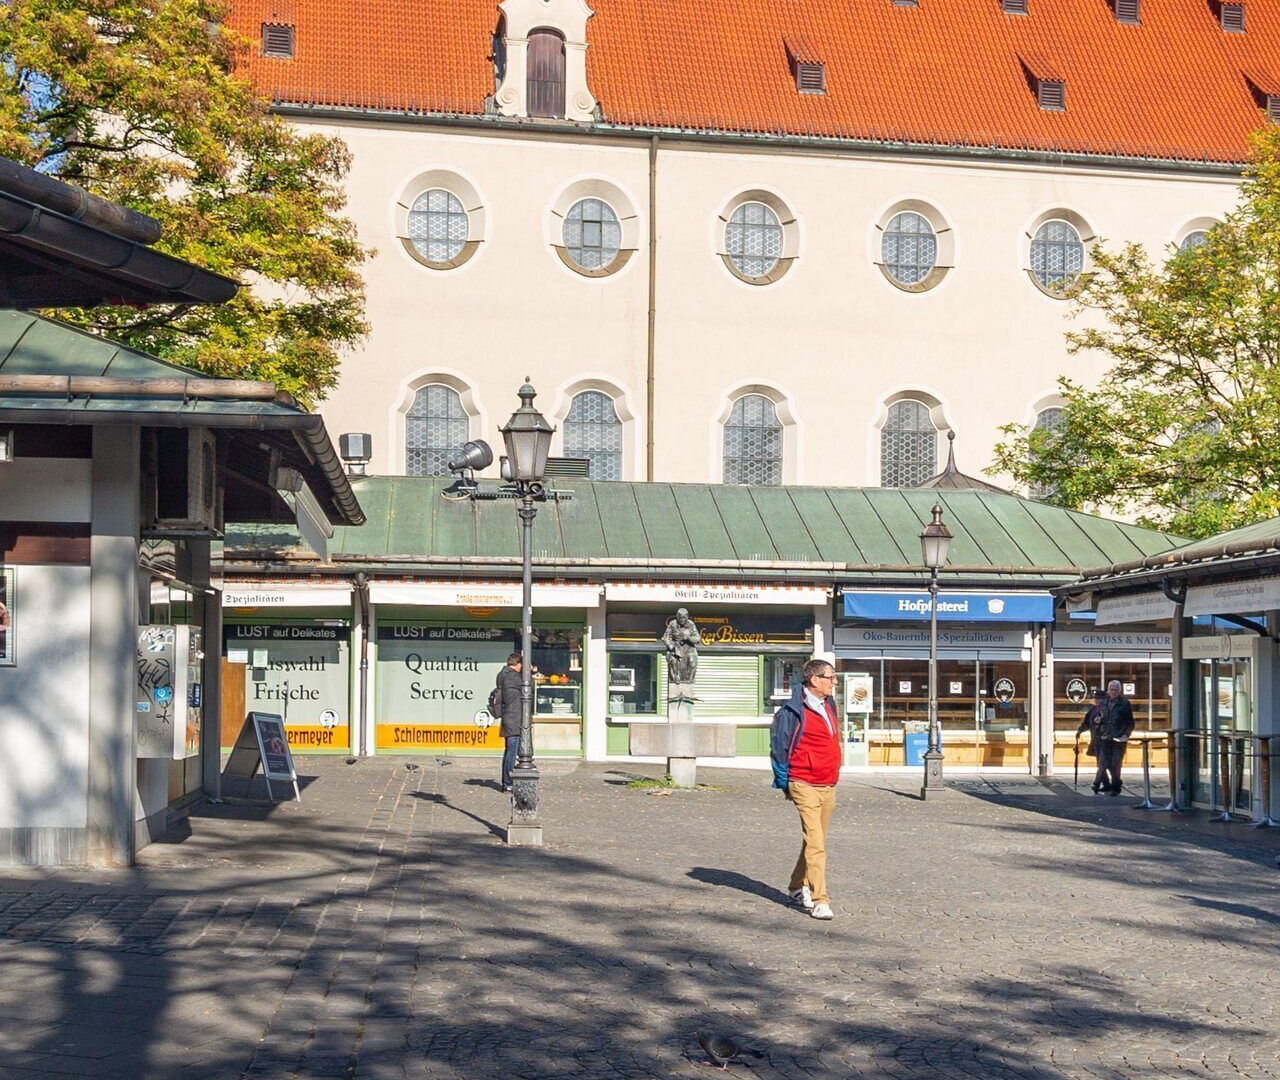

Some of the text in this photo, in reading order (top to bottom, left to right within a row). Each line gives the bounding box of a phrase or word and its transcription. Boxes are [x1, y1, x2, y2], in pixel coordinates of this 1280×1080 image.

[225, 594, 285, 604] Spezialitäten
[898, 600, 968, 614] Hofpfsterei
[237, 626, 336, 638] LUST auf Delikates
[394, 626, 491, 639] LUST auf Delikates
[863, 631, 1004, 644] Öko-Bauernbrt-Spezialitäten
[1082, 635, 1123, 645] GENUSS
[1126, 635, 1133, 645] &
[405, 653, 479, 674] Qualität
[254, 682, 320, 700] Frische
[411, 682, 473, 700] Service
[284, 730, 334, 744] ermeyer
[394, 727, 488, 745] Schlemmermeyer
